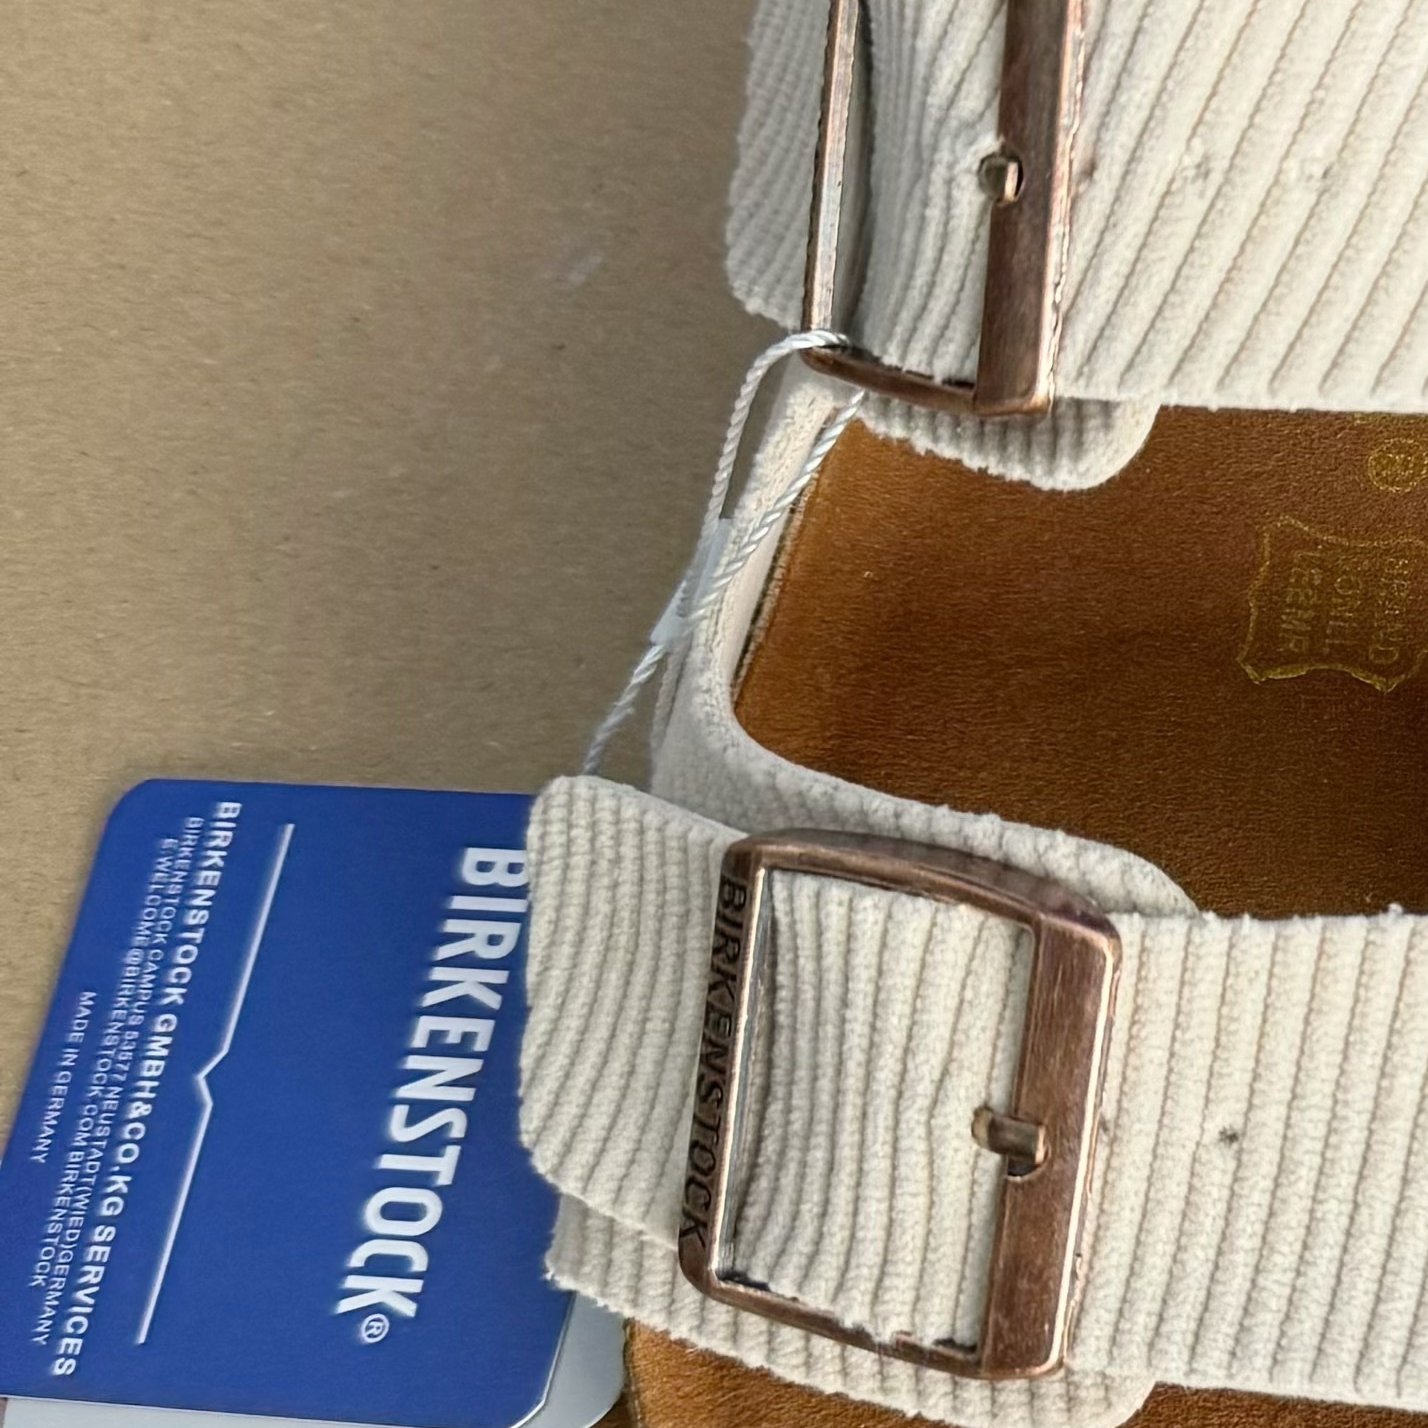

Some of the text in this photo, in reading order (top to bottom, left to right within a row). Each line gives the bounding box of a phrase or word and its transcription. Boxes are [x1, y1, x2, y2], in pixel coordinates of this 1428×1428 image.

[151, 818, 204, 944] BIRKENSTOCK
[160, 802, 242, 1005] BIRKENSTOCK
[128, 949, 164, 1026] CAMPUS
[678, 874, 747, 1249] BIRKENSTOCK
[31, 992, 98, 1163] MADE IN GERMANY
[29, 1153, 83, 1286] BIRKENSTOCK
[52, 1224, 117, 1377] SERVICES
